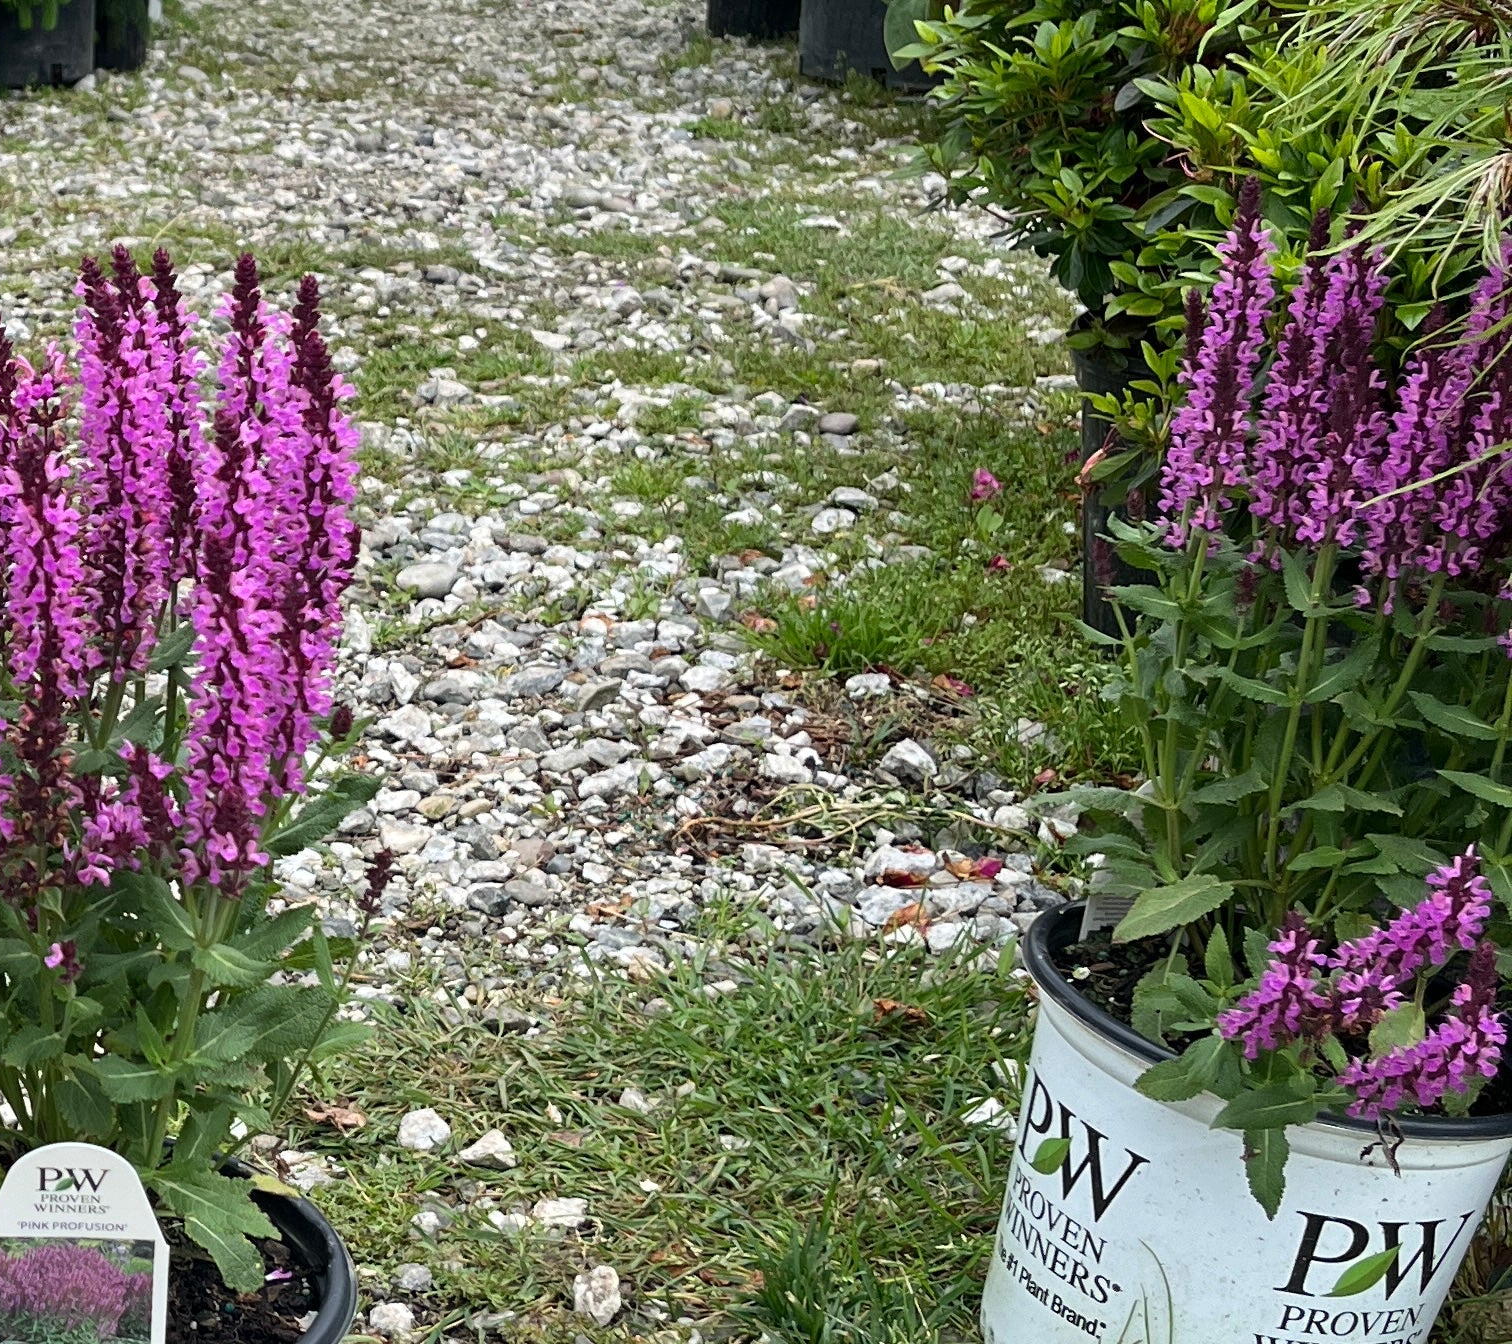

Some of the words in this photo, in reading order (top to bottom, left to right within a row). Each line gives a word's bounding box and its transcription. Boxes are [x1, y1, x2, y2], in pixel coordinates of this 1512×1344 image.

[1019, 1067, 1151, 1223] PW
[36, 1166, 111, 1193] PW
[40, 1193, 101, 1204] PROVEN
[1013, 1165, 1108, 1264] PROVEN
[1273, 1210, 1476, 1301] PW
[1019, 1266, 1050, 1306] Plant
[1276, 1303, 1426, 1336] PROVEN
